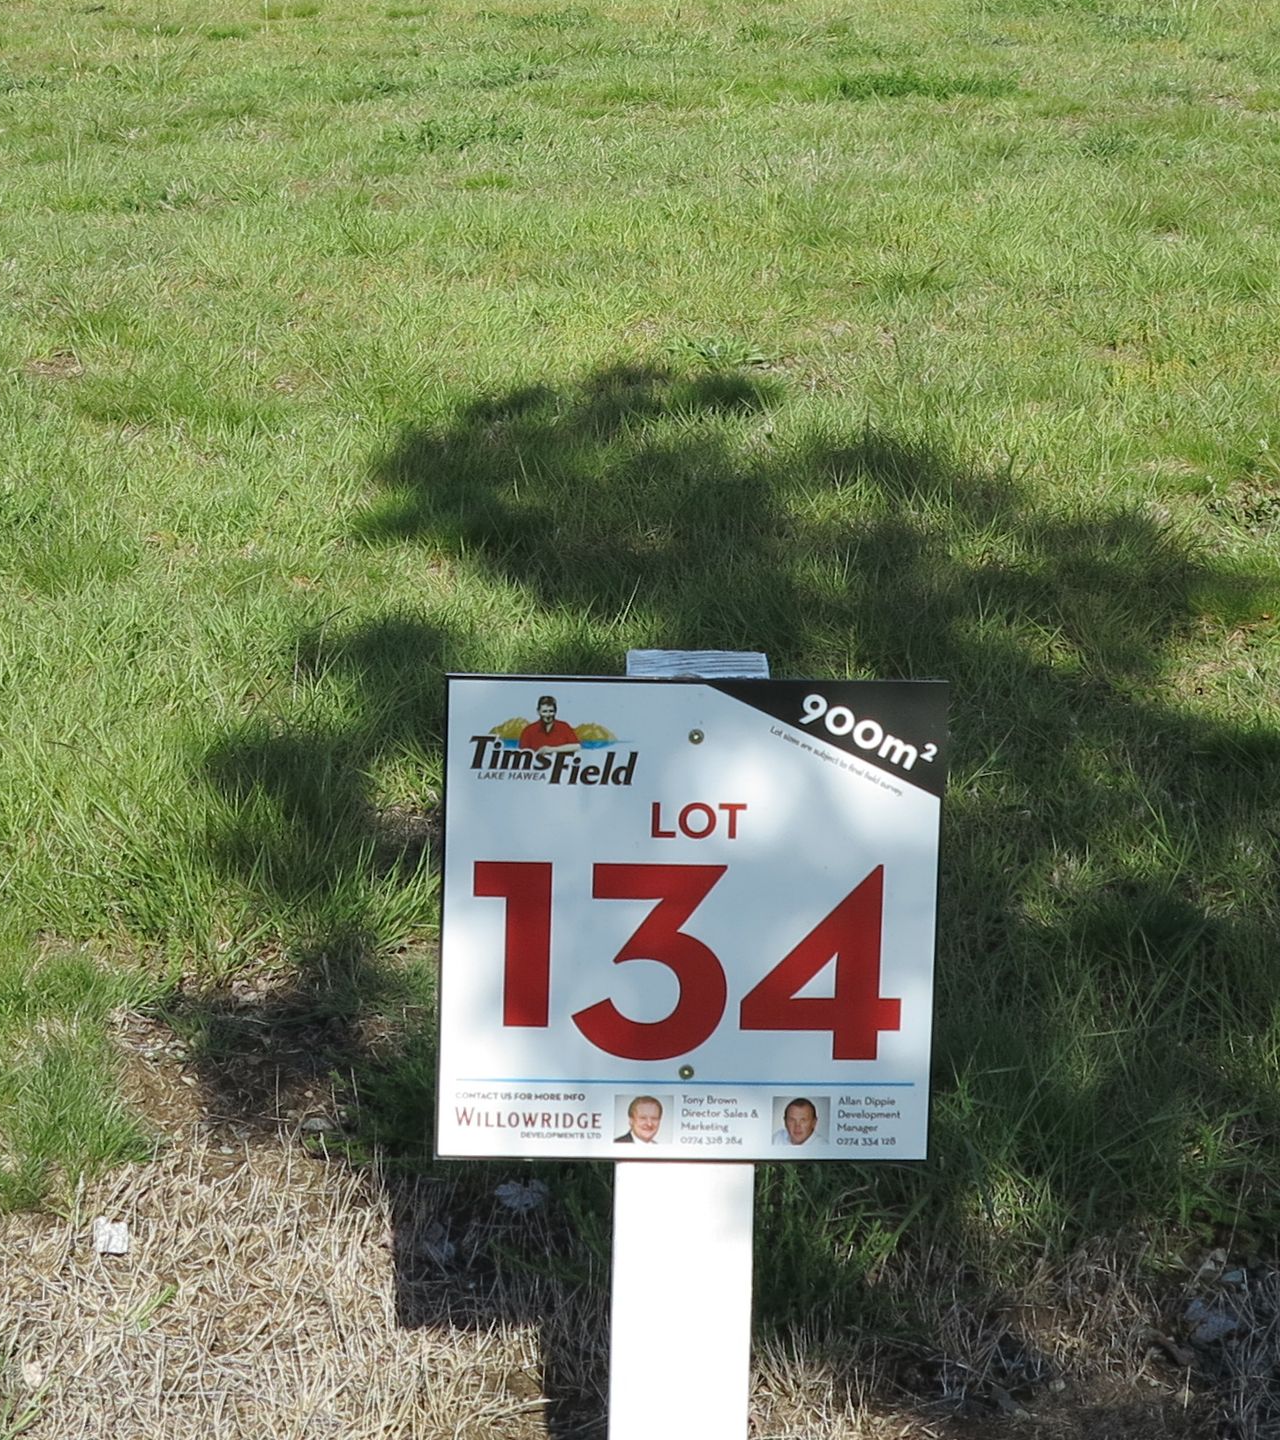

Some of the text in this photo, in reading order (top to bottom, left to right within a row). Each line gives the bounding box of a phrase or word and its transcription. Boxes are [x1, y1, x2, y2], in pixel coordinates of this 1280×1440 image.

[770, 725, 783, 737] Lot
[813, 748, 839, 766] subject
[477, 771, 547, 781] LAKE HAWEA
[651, 802, 747, 839] LOT
[473, 861, 902, 1061] 134
[455, 1092, 586, 1101] CONTACT US FOR MORE INFO
[682, 1094, 738, 1106] Tony Brown
[838, 1096, 896, 1108] Allan Dippie
[681, 1108, 759, 1119] Director Sales &
[837, 1109, 901, 1121] Development
[680, 1121, 729, 1133] Marketing
[836, 1123, 878, 1134] Manager
[520, 1131, 585, 1139] DEVELOPMENTS
[836, 1137, 897, 1146] 0274 334 128
